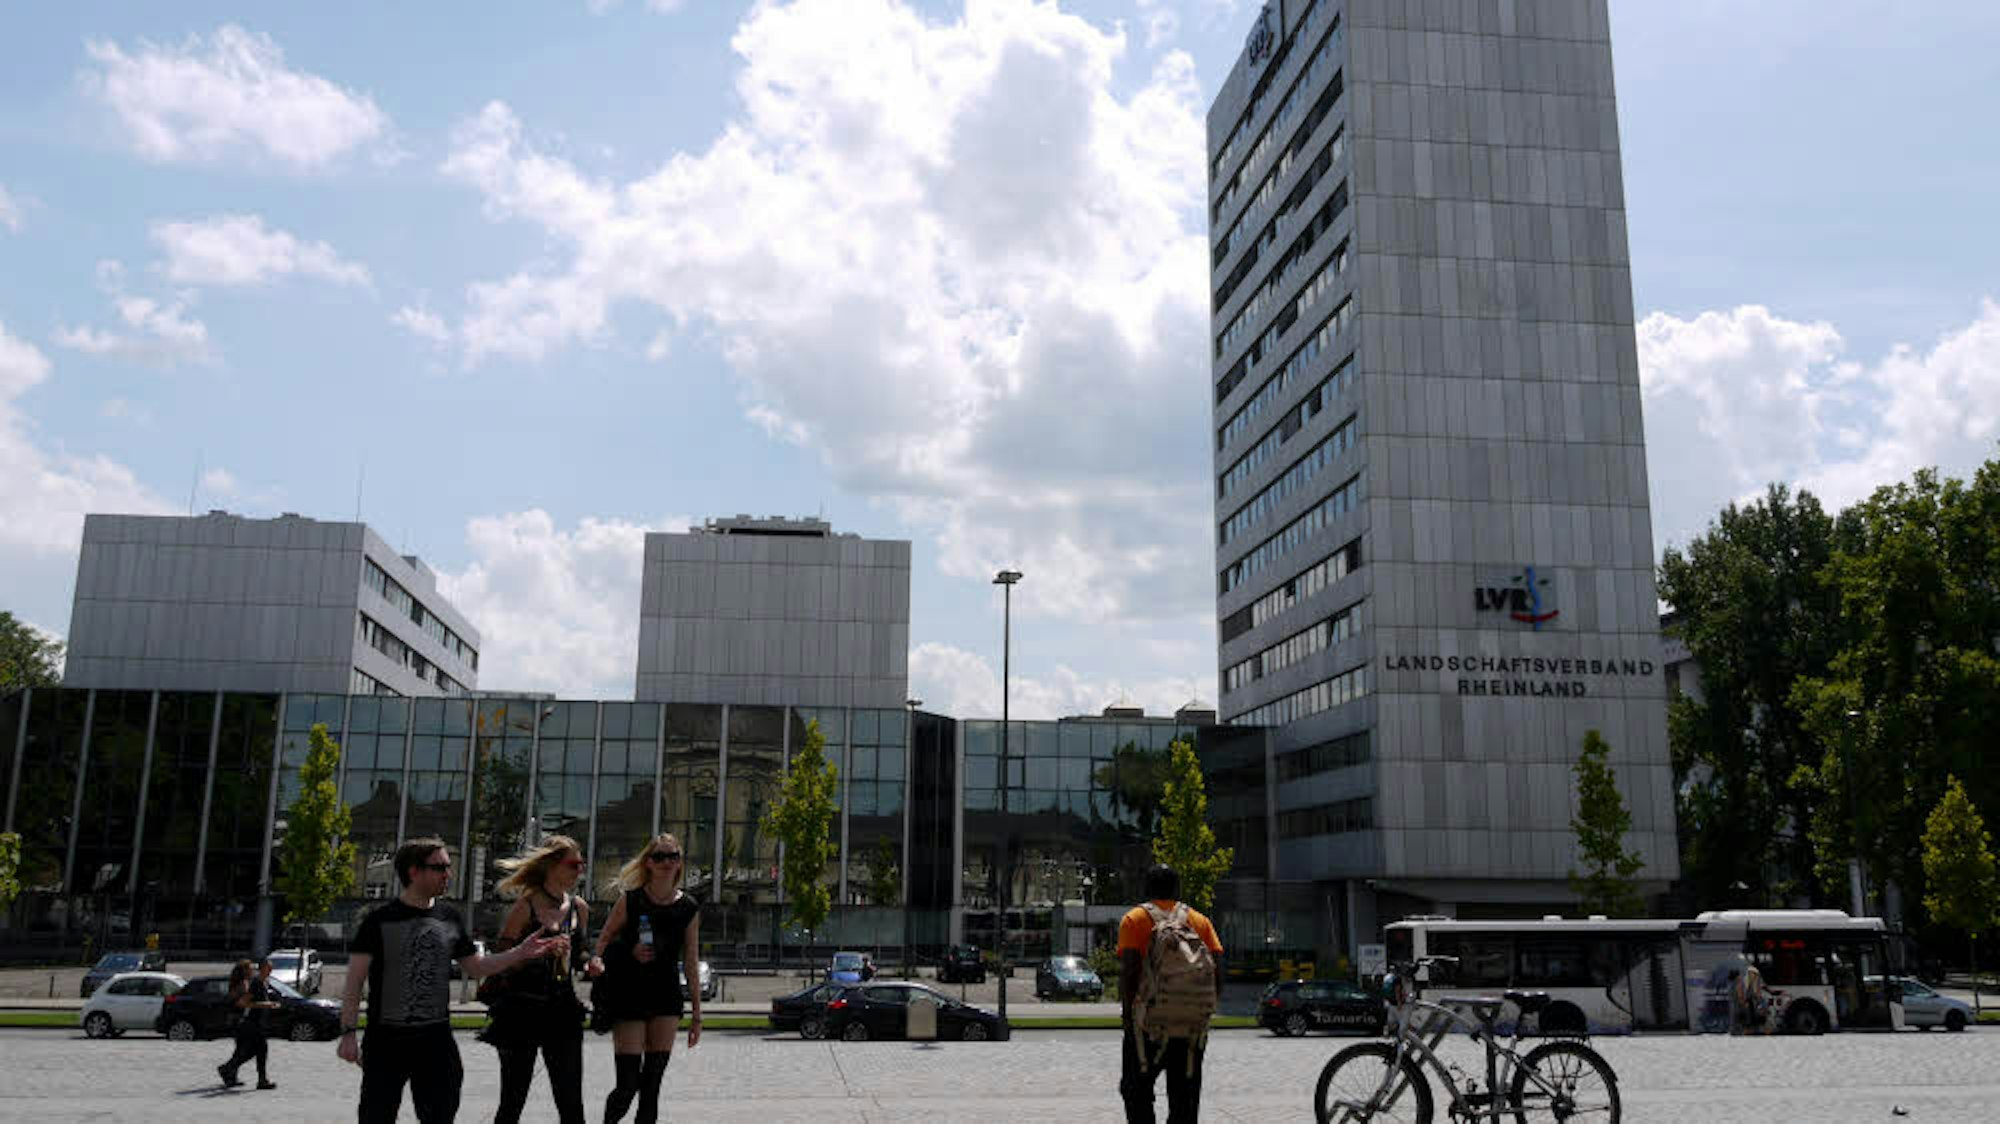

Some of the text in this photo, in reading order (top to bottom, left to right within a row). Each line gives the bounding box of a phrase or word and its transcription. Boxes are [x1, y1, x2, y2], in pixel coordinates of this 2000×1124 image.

[1475, 587, 1530, 612] LVR
[1385, 655, 1653, 676] LANDSCHAFTSVERBAND
[1457, 679, 1586, 698] RHEINLAND
